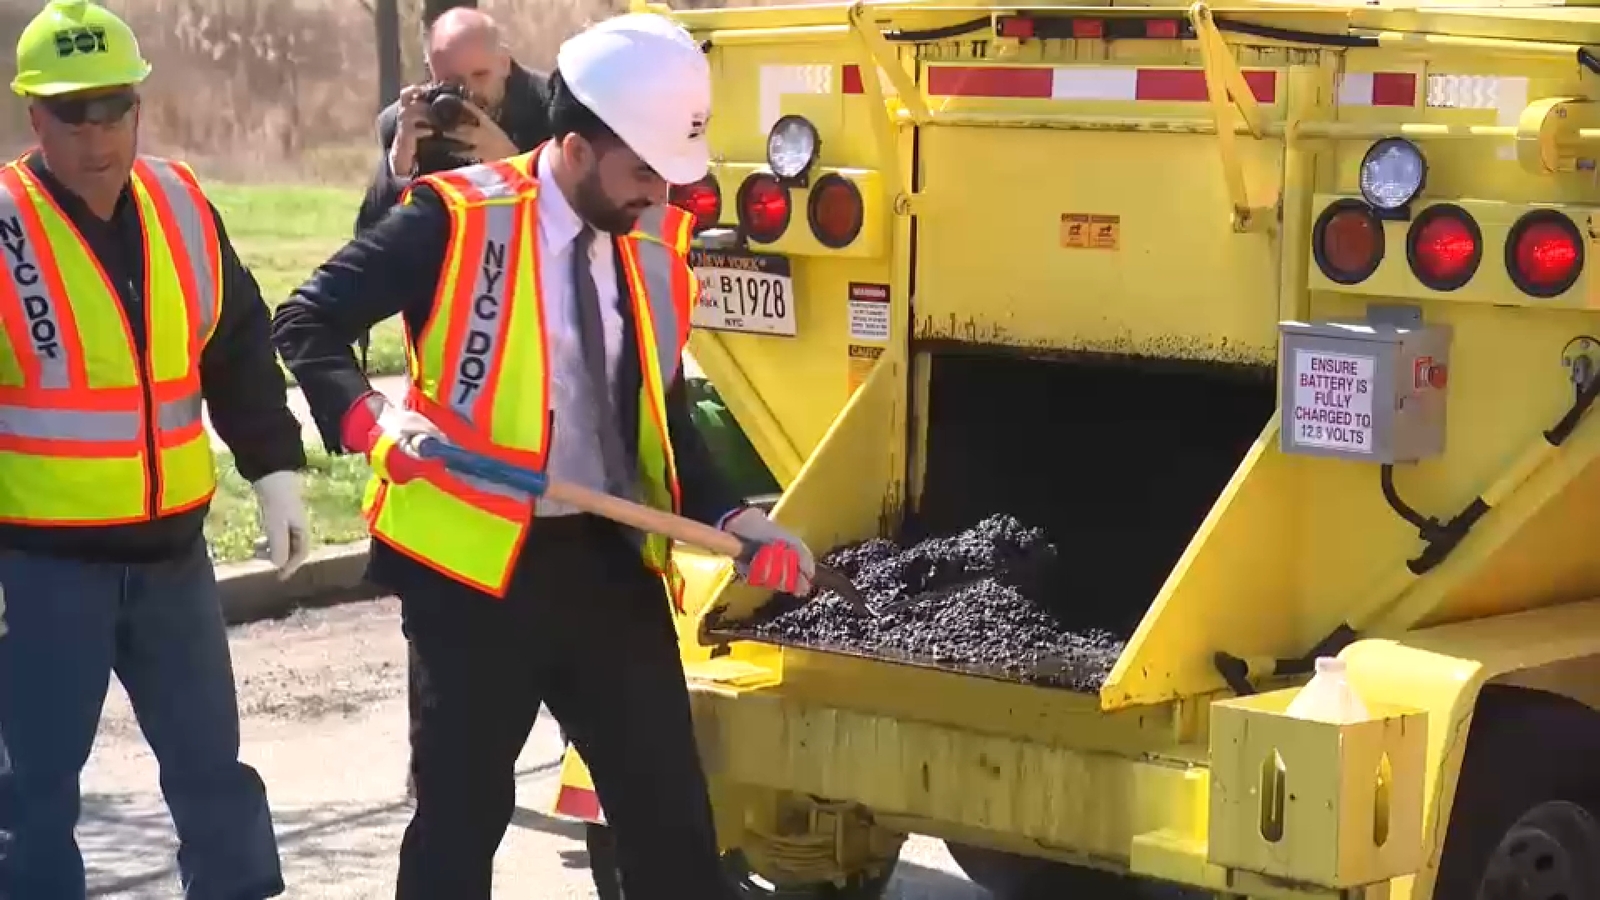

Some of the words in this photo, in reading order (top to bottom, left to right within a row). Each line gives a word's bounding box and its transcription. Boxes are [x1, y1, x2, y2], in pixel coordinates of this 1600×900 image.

[54, 27, 108, 58] DOT
[0, 216, 38, 286] NYC
[23, 295, 58, 359] DOT
[475, 240, 505, 321] NYC
[724, 318, 743, 328] NYC
[458, 330, 492, 404] DOT
[1311, 357, 1359, 376] ENSURE
[1300, 373, 1354, 392] BATTERY
[1356, 379, 1368, 394] IS
[1314, 391, 1352, 408] FULLY
[1295, 406, 1352, 426] CHARGED
[1355, 413, 1371, 427] TO
[1326, 427, 1365, 444] VOLTS
